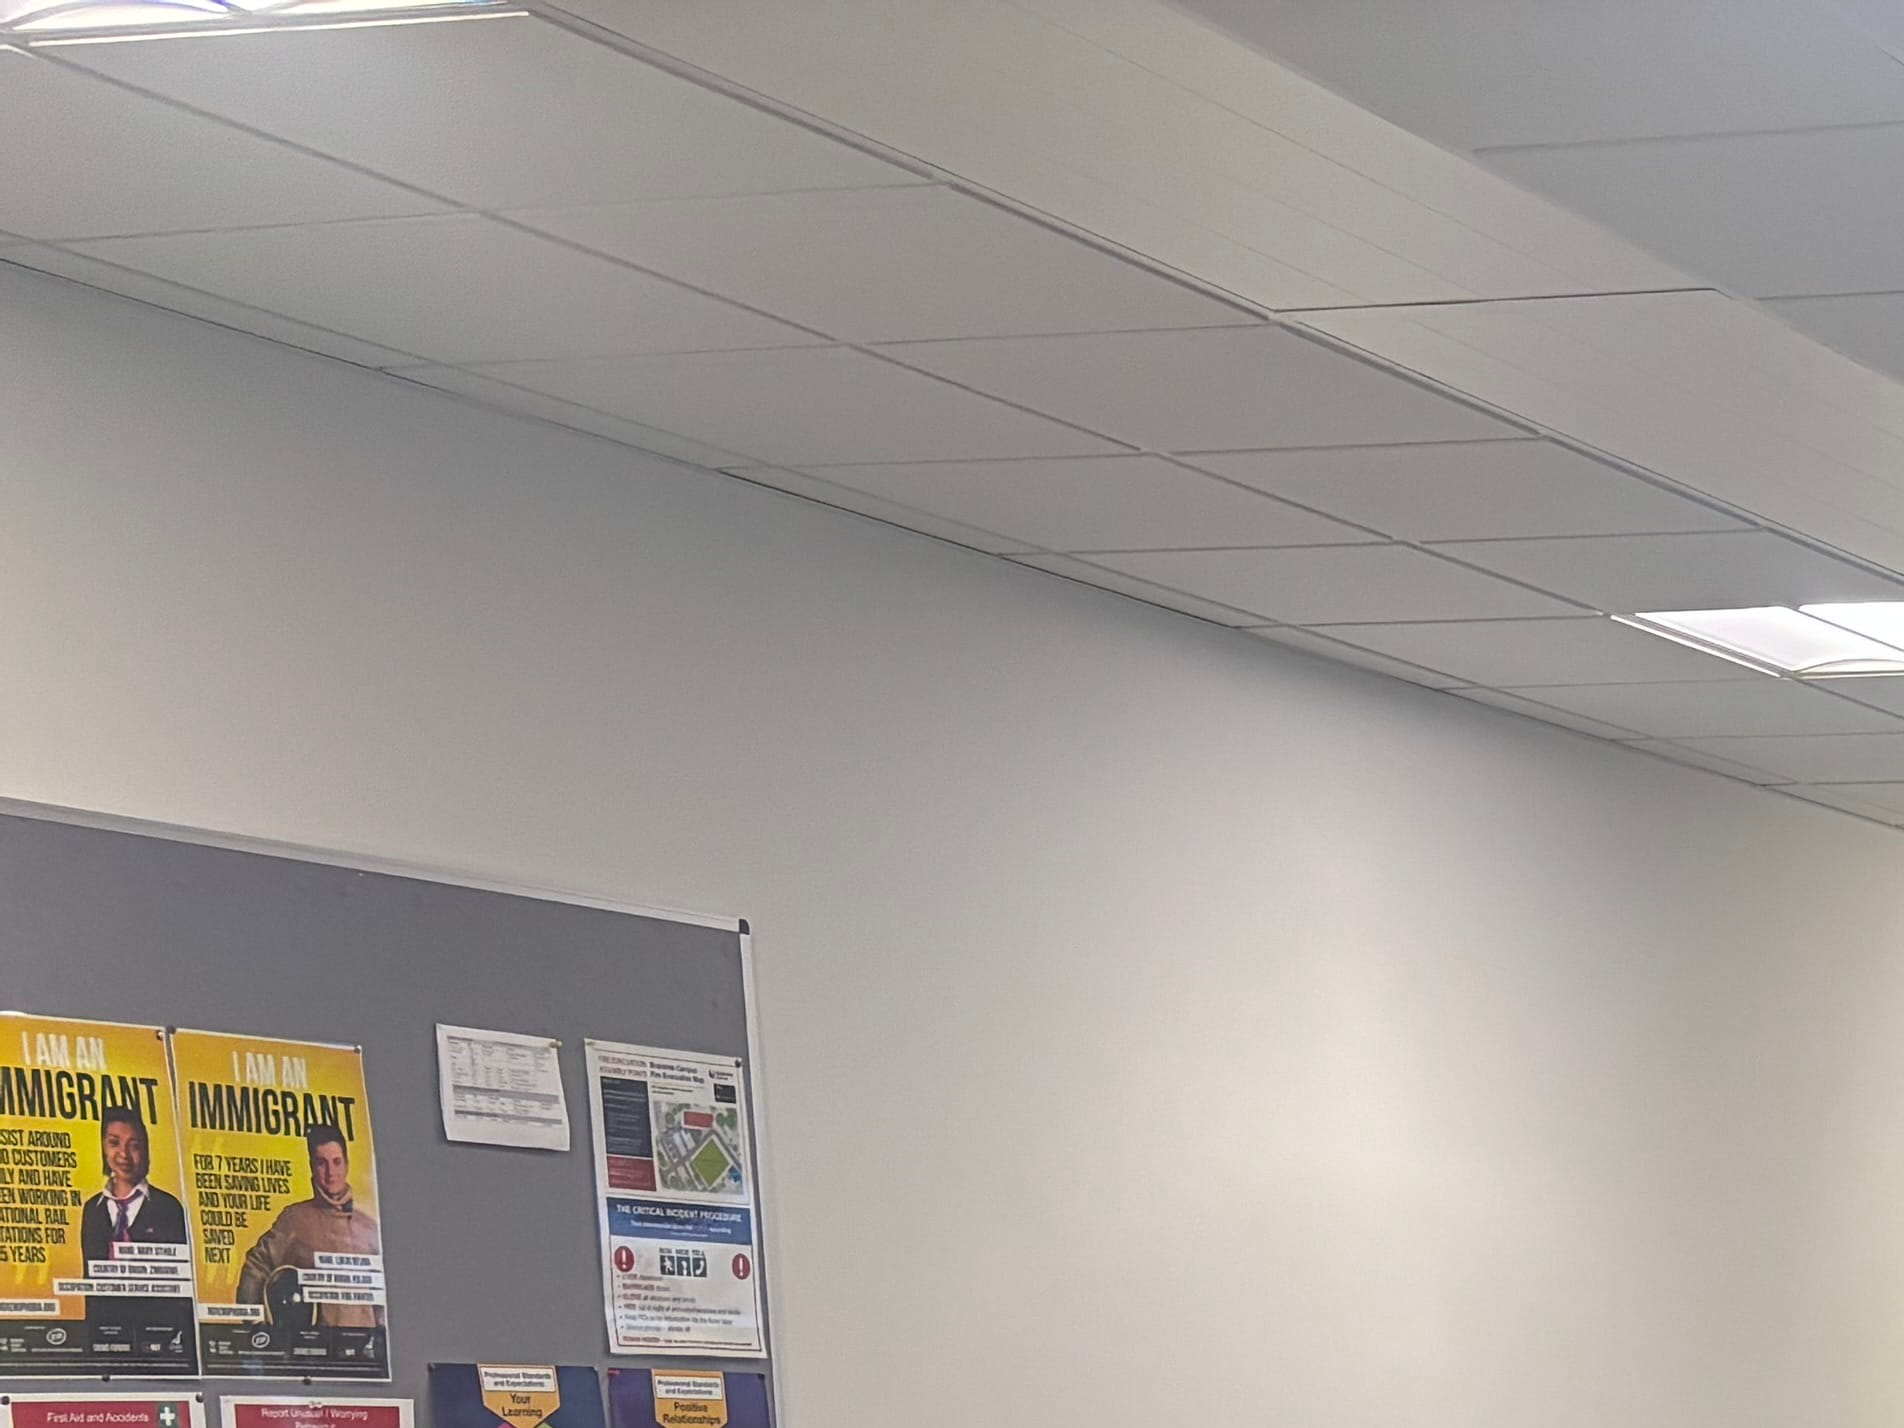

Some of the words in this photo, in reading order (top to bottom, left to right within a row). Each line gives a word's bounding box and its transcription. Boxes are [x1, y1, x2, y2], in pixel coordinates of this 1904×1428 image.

[22, 1032, 31, 1065] I
[36, 1033, 70, 1069] AM
[76, 1036, 107, 1071] AN
[232, 1051, 240, 1082] I
[246, 1052, 276, 1086] AM
[282, 1056, 308, 1090] AN
[188, 1081, 355, 1141] IMMIGRANT
[28, 1130, 71, 1149] AROUND
[12, 1149, 77, 1168] CUSTOMERS
[194, 1153, 214, 1171] FOR
[216, 1156, 222, 1172] 7
[225, 1156, 258, 1174] YEARS
[267, 1159, 292, 1177] HAVE
[19, 1169, 40, 1185] AND
[43, 1170, 72, 1187] HAVE
[196, 1173, 222, 1190] BEEN
[225, 1176, 260, 1193] SAVING
[262, 1178, 290, 1194] LIVES
[18, 1188, 68, 1206] WORKING
[70, 1190, 82, 1206] IN
[199, 1191, 219, 1208] AND
[223, 1193, 248, 1210] YOUR
[251, 1194, 271, 1211] LIFE
[45, 1208, 69, 1225] RAIL
[200, 1210, 232, 1227] COULD
[234, 1211, 248, 1228] BE
[616, 1204, 631, 1214] THE
[632, 1205, 664, 1217] CRITICAL
[666, 1208, 699, 1220] INCIDENT
[45, 1227, 66, 1244] FOR
[203, 1229, 235, 1246] SAVED
[10, 1246, 46, 1263] YEARS
[205, 1247, 231, 1265] NEXT
[510, 1393, 531, 1404] Your
[674, 1401, 708, 1412] Positive
[47, 1411, 68, 1423] First
[69, 1412, 85, 1423] Aid
[86, 1412, 104, 1423] and
[105, 1412, 149, 1423] Accidents
[261, 1408, 289, 1420] Report
[291, 1407, 323, 1419] Unusual
[331, 1408, 368, 1421] Worrying
[502, 1406, 543, 1419] Learning
[663, 1414, 721, 1426] Relationships
